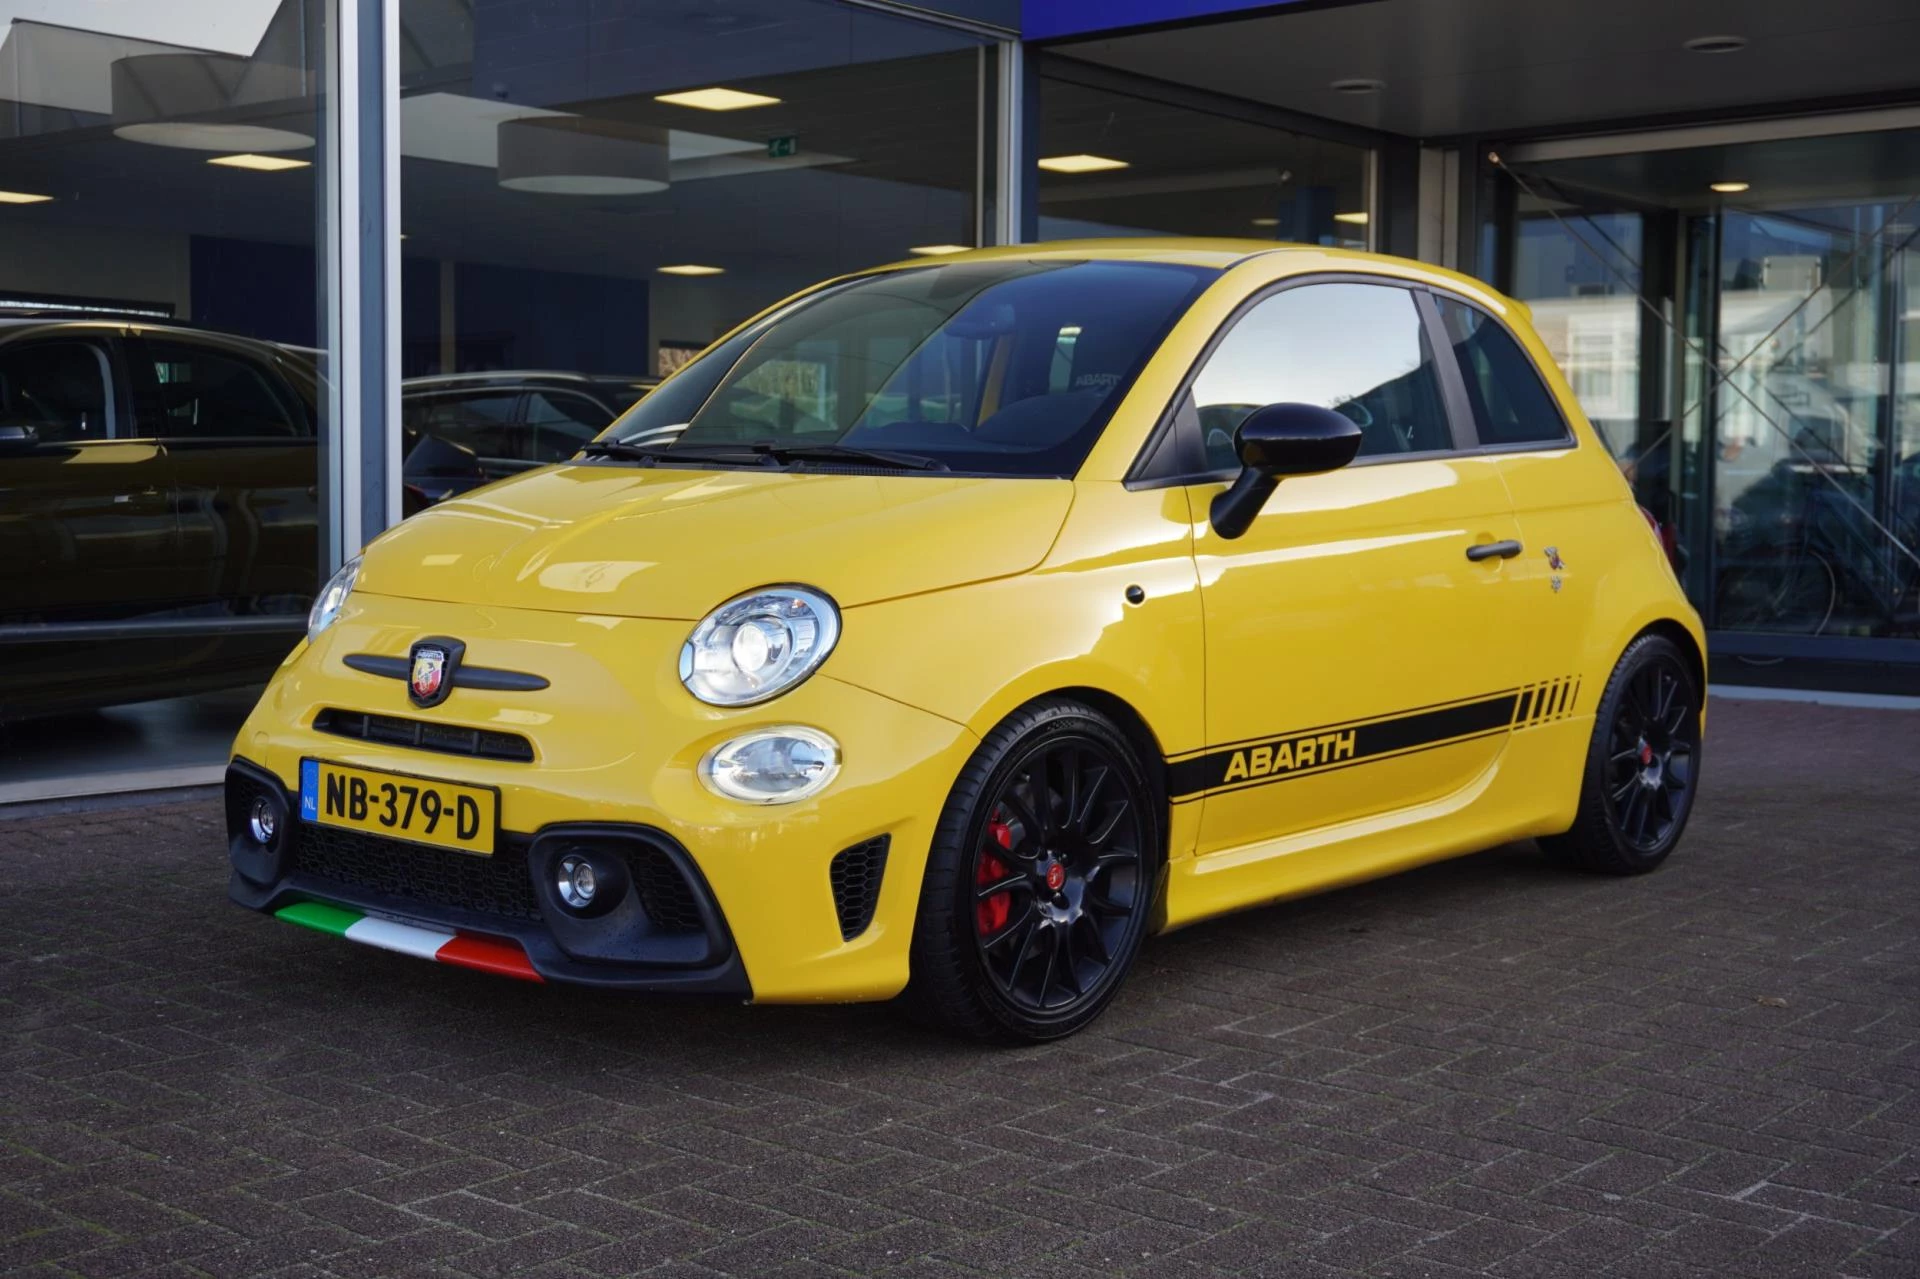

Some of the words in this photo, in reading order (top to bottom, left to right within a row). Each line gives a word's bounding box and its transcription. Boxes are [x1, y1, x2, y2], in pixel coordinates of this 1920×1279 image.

[1075, 373, 1122, 387] ABART
[1224, 730, 1356, 782] ABARTH
[304, 796, 316, 811] NL
[325, 773, 480, 840] NB-379-D
